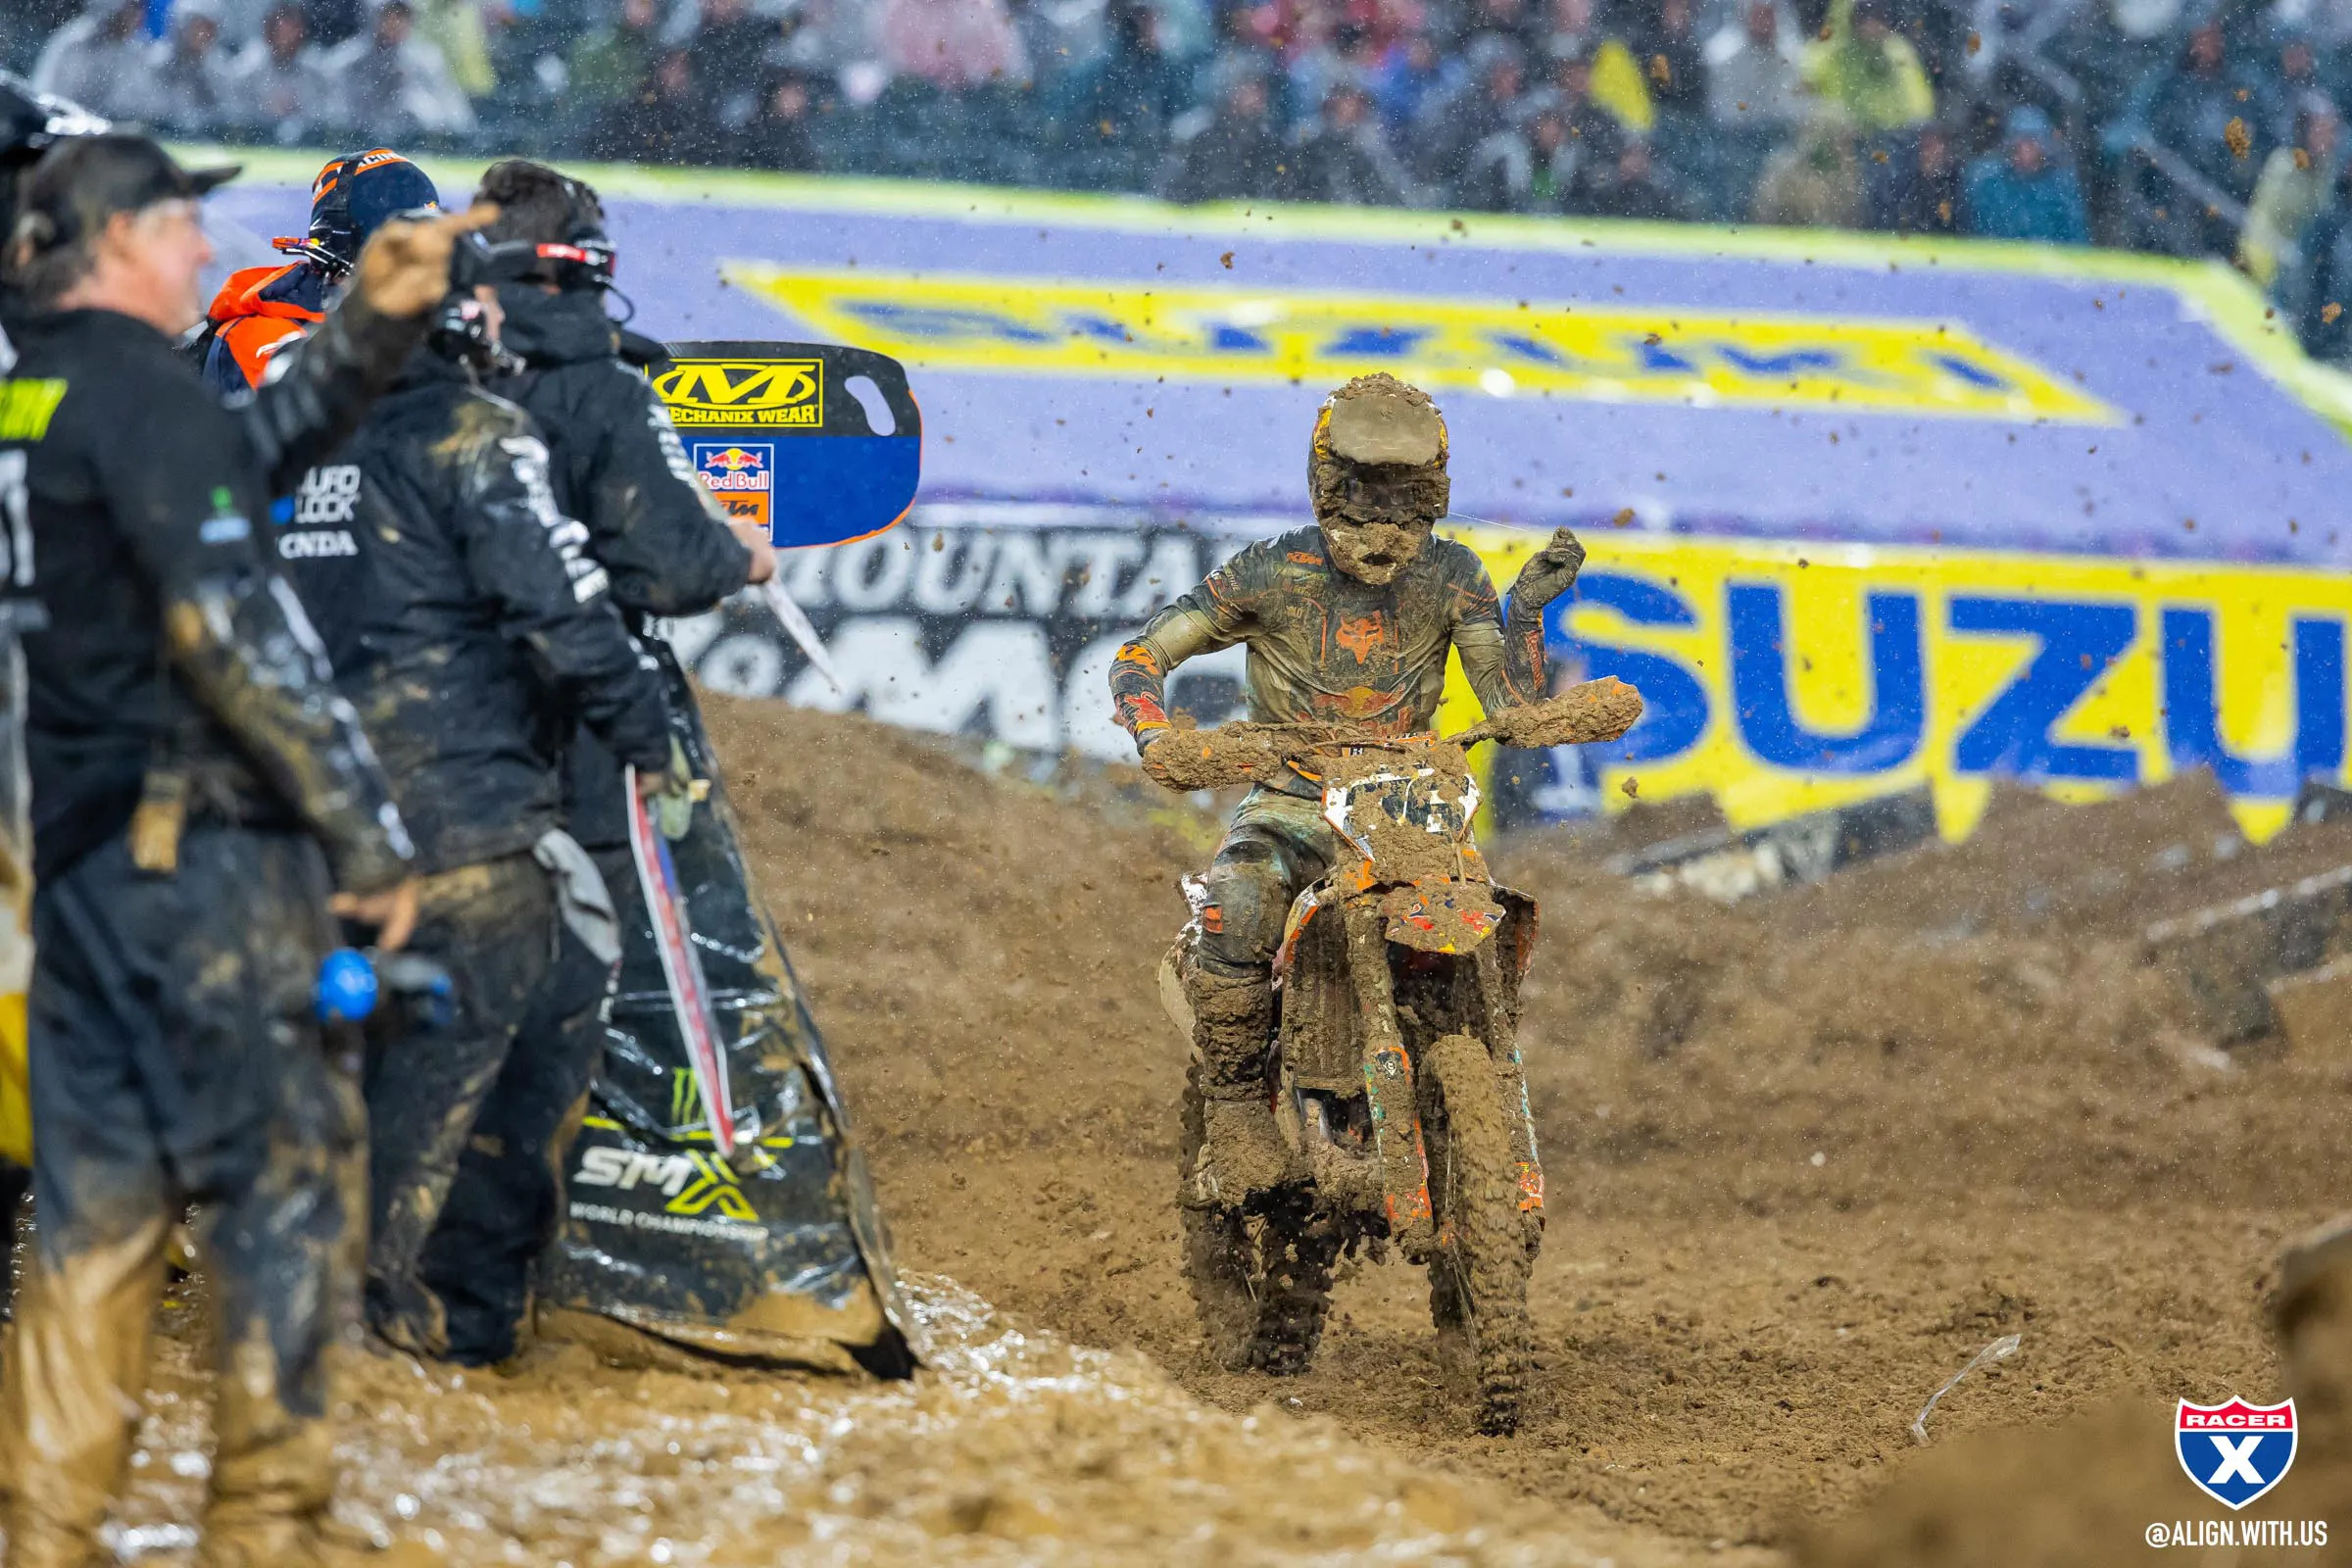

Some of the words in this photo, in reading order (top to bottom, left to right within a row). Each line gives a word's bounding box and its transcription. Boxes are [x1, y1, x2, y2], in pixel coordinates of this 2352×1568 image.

[668, 407, 754, 423] ECHANIX
[758, 405, 816, 423] WEAR
[699, 472, 732, 489] Red
[736, 471, 768, 489] Bull
[278, 530, 359, 560] ONDA
